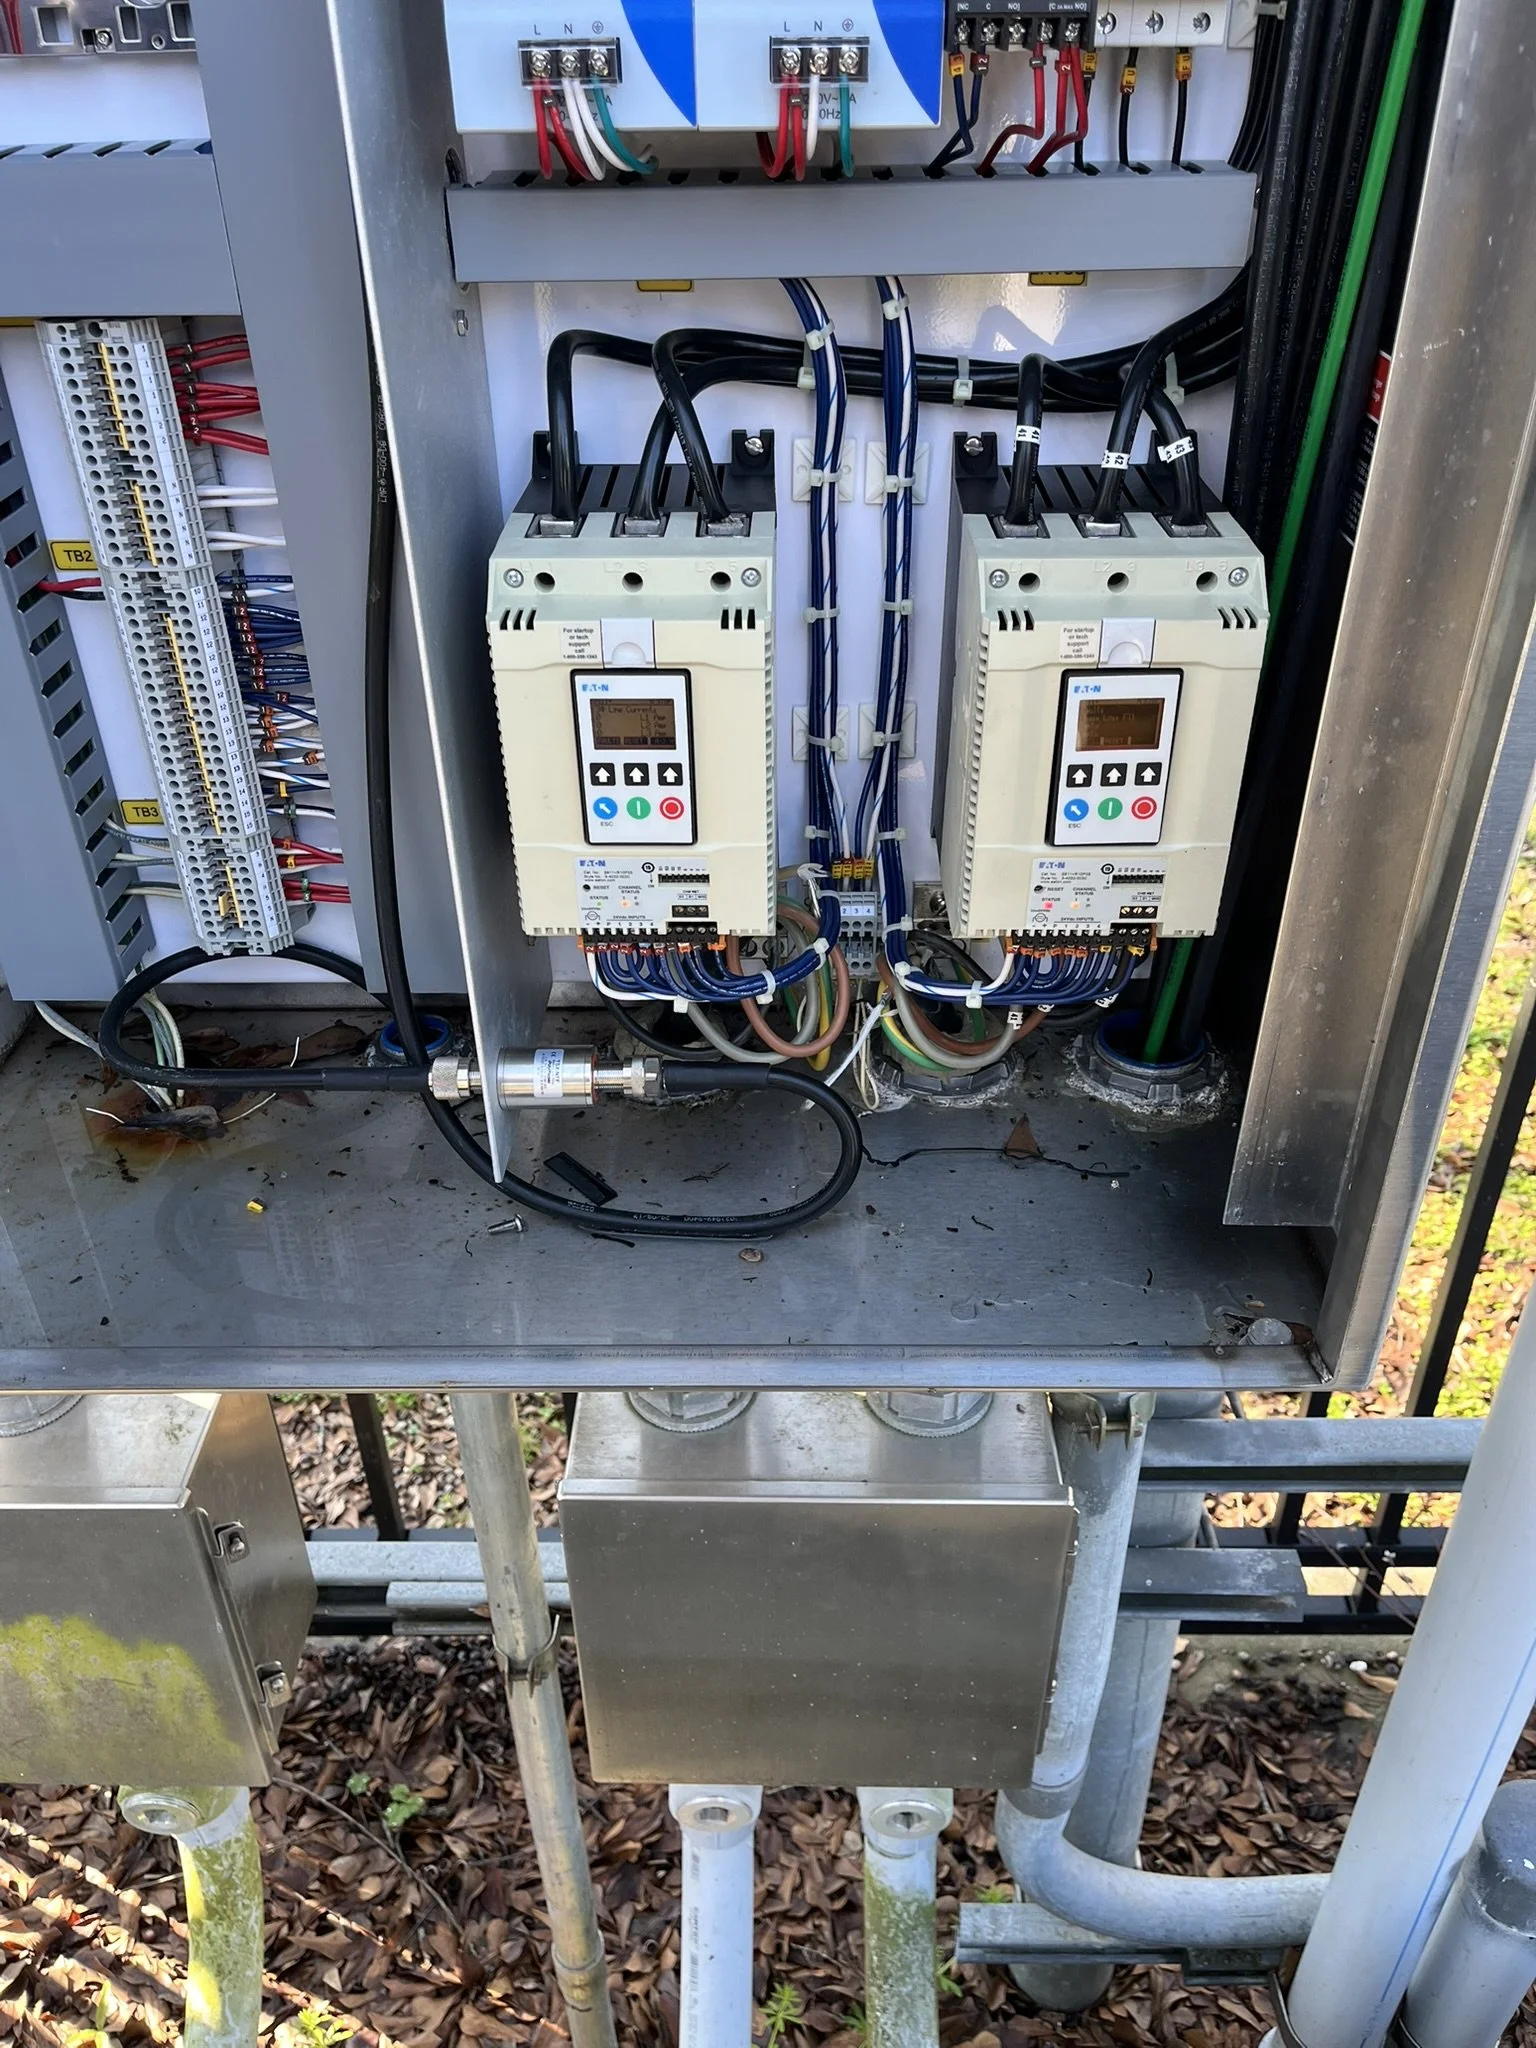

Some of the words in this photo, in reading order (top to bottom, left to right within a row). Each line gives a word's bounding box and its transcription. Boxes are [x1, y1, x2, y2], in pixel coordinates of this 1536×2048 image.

[534, 24, 541, 35] L
[564, 24, 573, 34] N
[784, 21, 791, 32] L
[814, 21, 823, 32] N
[1018, 428, 1028, 438] 41
[1175, 443, 1186, 456] 43
[1114, 454, 1124, 466] 42
[63, 550, 94, 562] TB2
[132, 807, 158, 818] TB3
